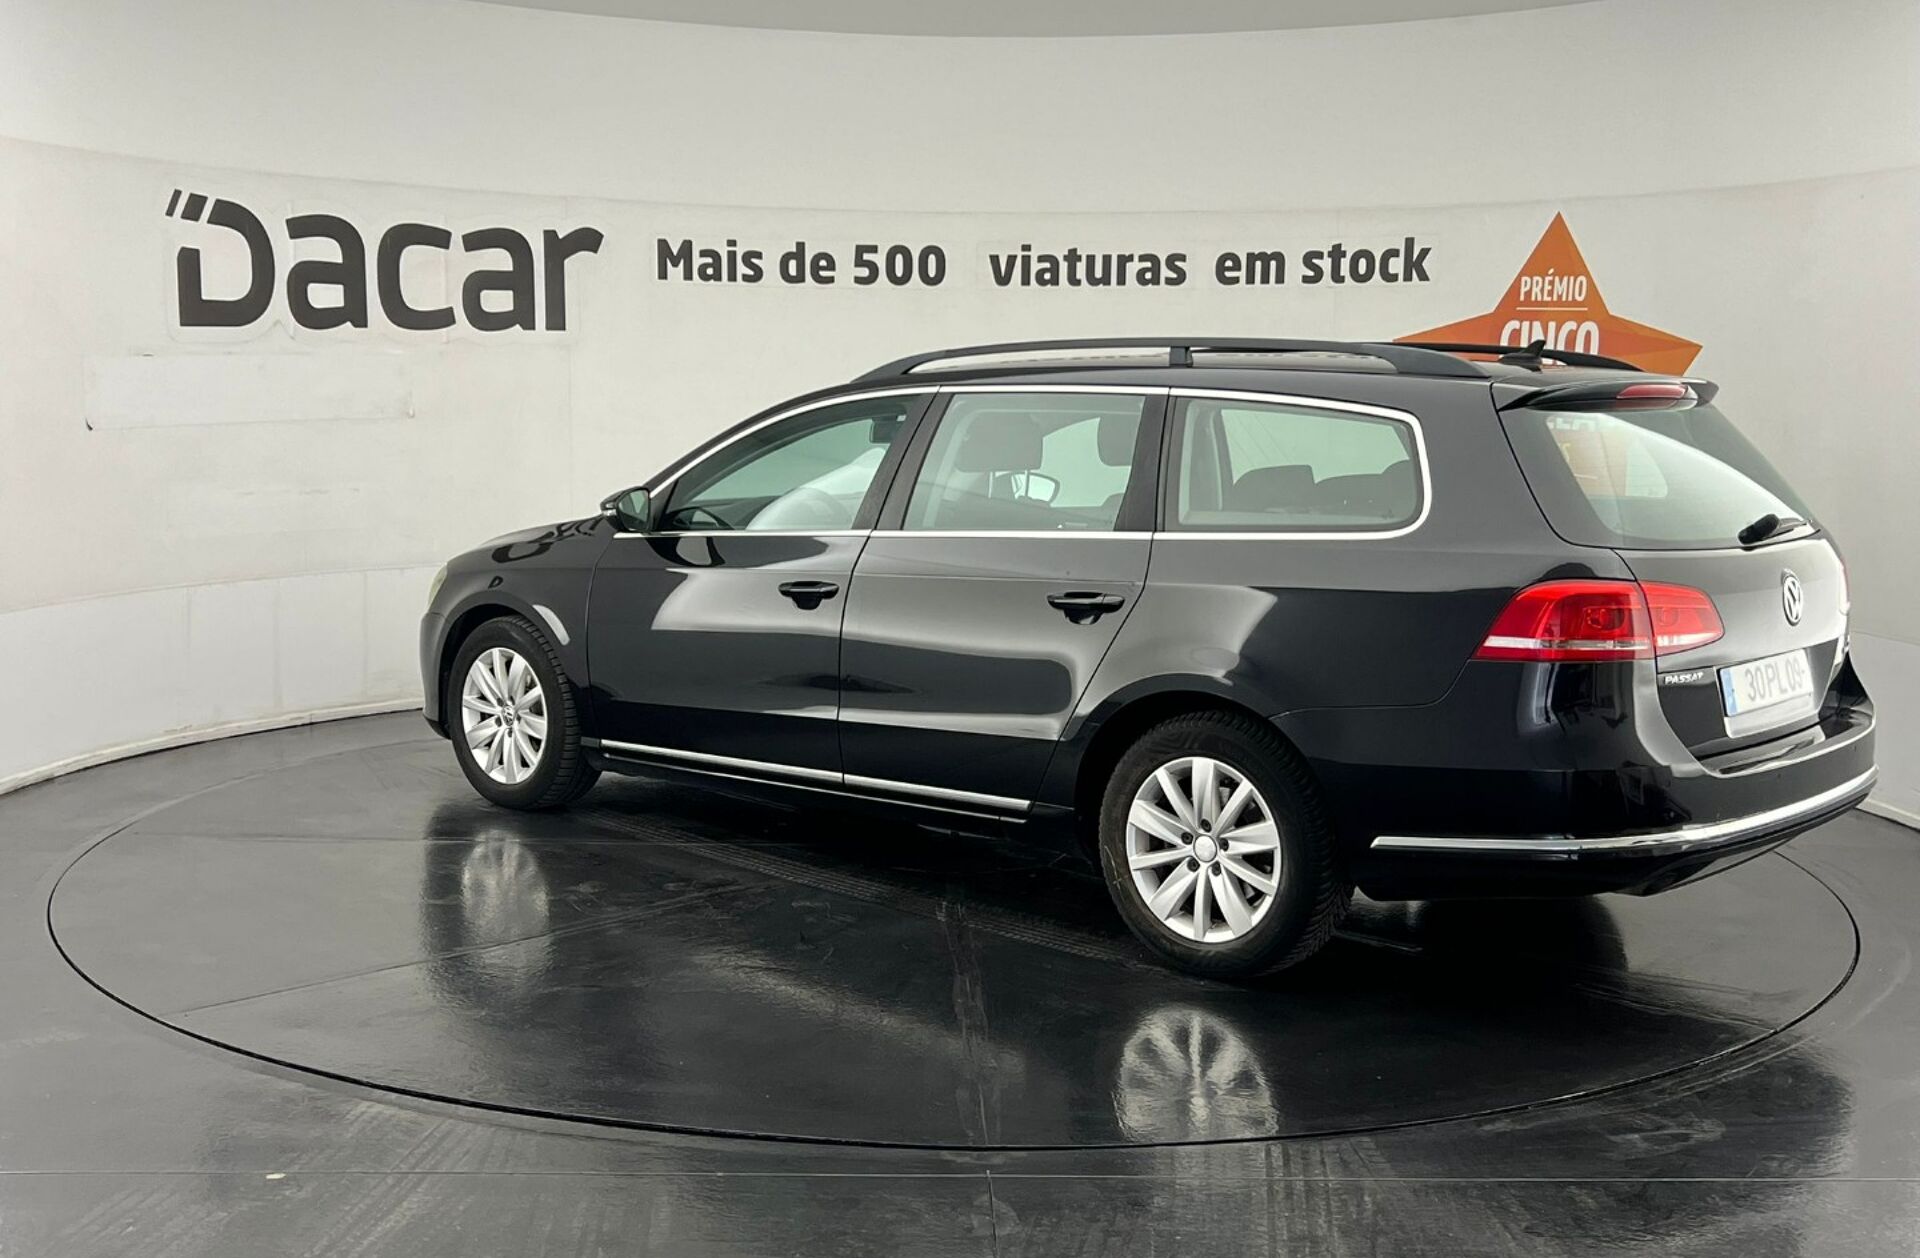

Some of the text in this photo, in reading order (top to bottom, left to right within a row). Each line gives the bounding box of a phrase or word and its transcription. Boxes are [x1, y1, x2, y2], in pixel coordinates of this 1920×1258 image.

[166, 188, 604, 332] Dacar
[657, 237, 1432, 287] Mais de 500 viaturas em stock
[1519, 268, 1588, 302] PRÉMIO
[1664, 671, 1704, 685] PASSAT
